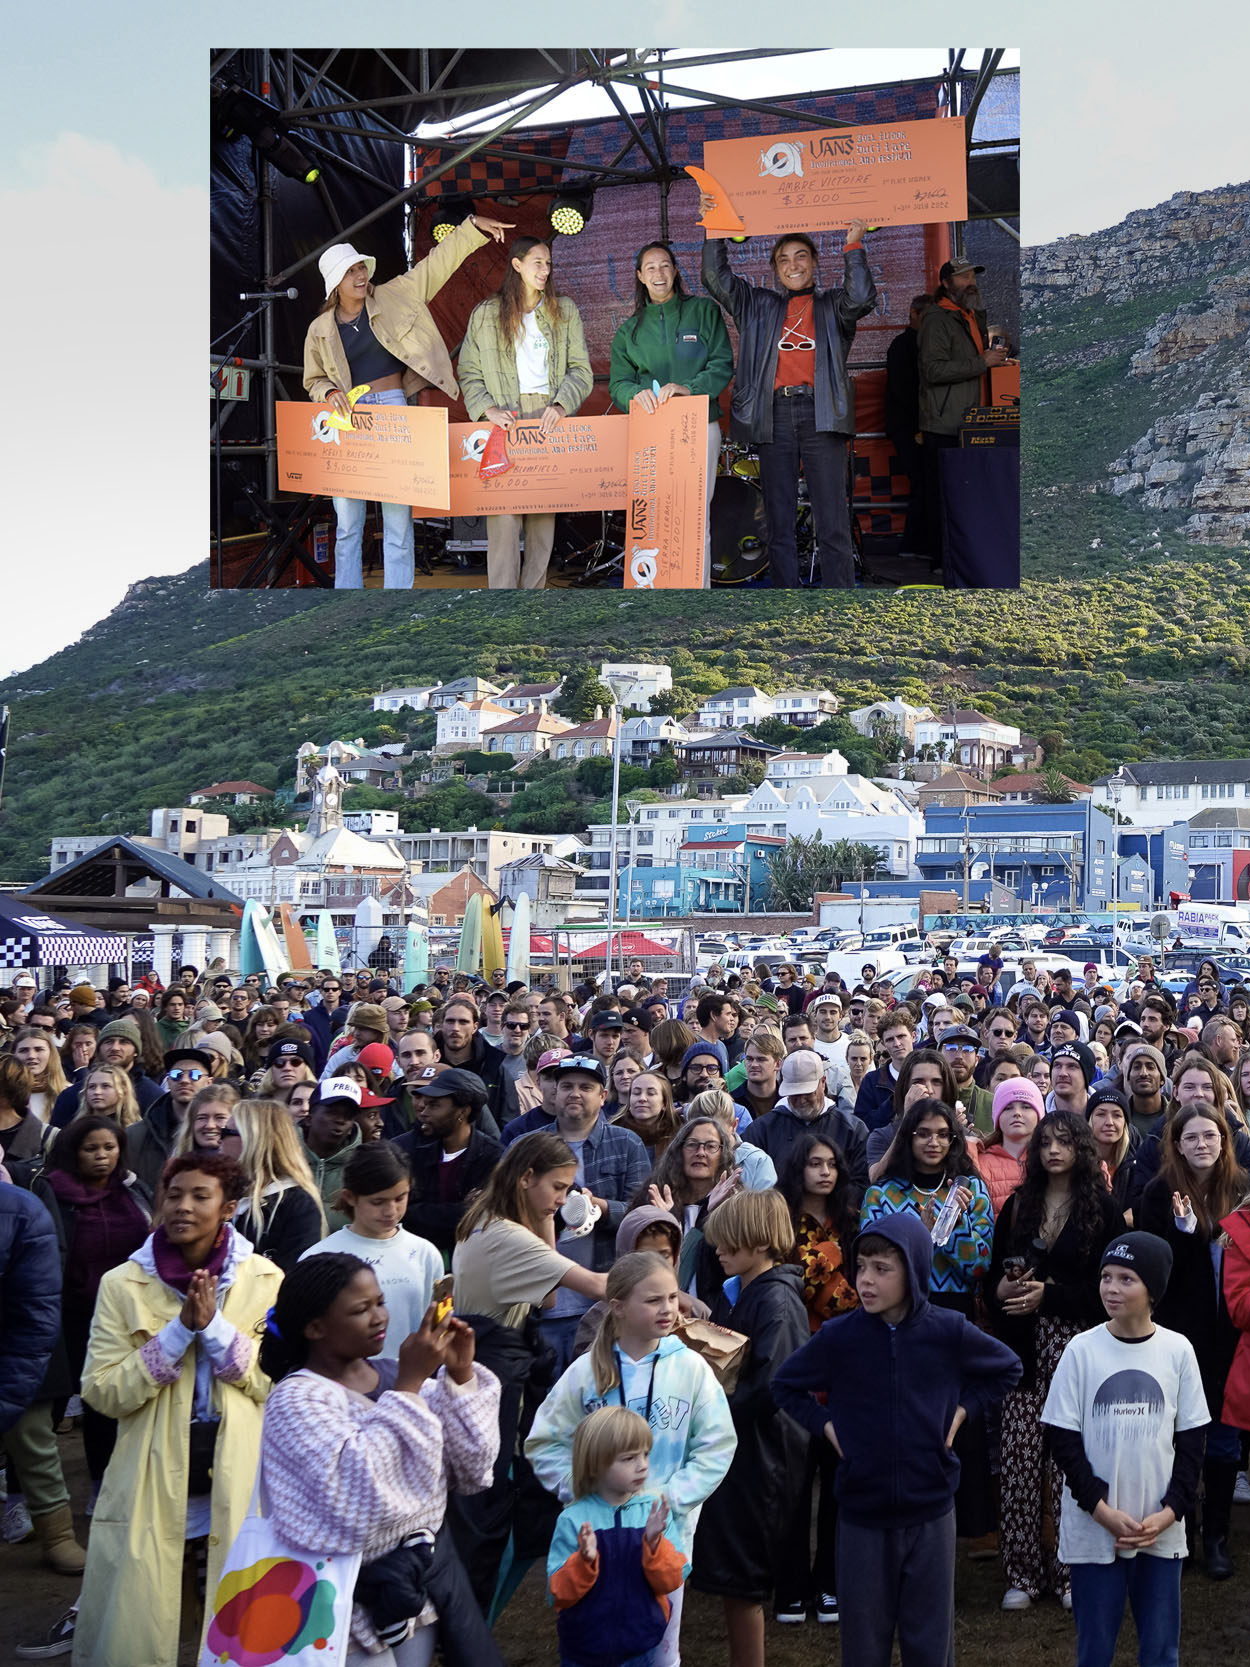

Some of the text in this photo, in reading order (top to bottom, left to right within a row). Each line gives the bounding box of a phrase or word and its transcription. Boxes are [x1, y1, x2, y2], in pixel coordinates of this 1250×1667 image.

[809, 134, 854, 159] VANS
[778, 174, 872, 193] AMBRE VICTOIRE
[507, 425, 547, 447] VANS
[632, 498, 648, 541] VANS
[1178, 911, 1205, 924] RABIA
[421, 1067, 436, 1078] B
[1113, 1407, 1137, 1416] Hurley
